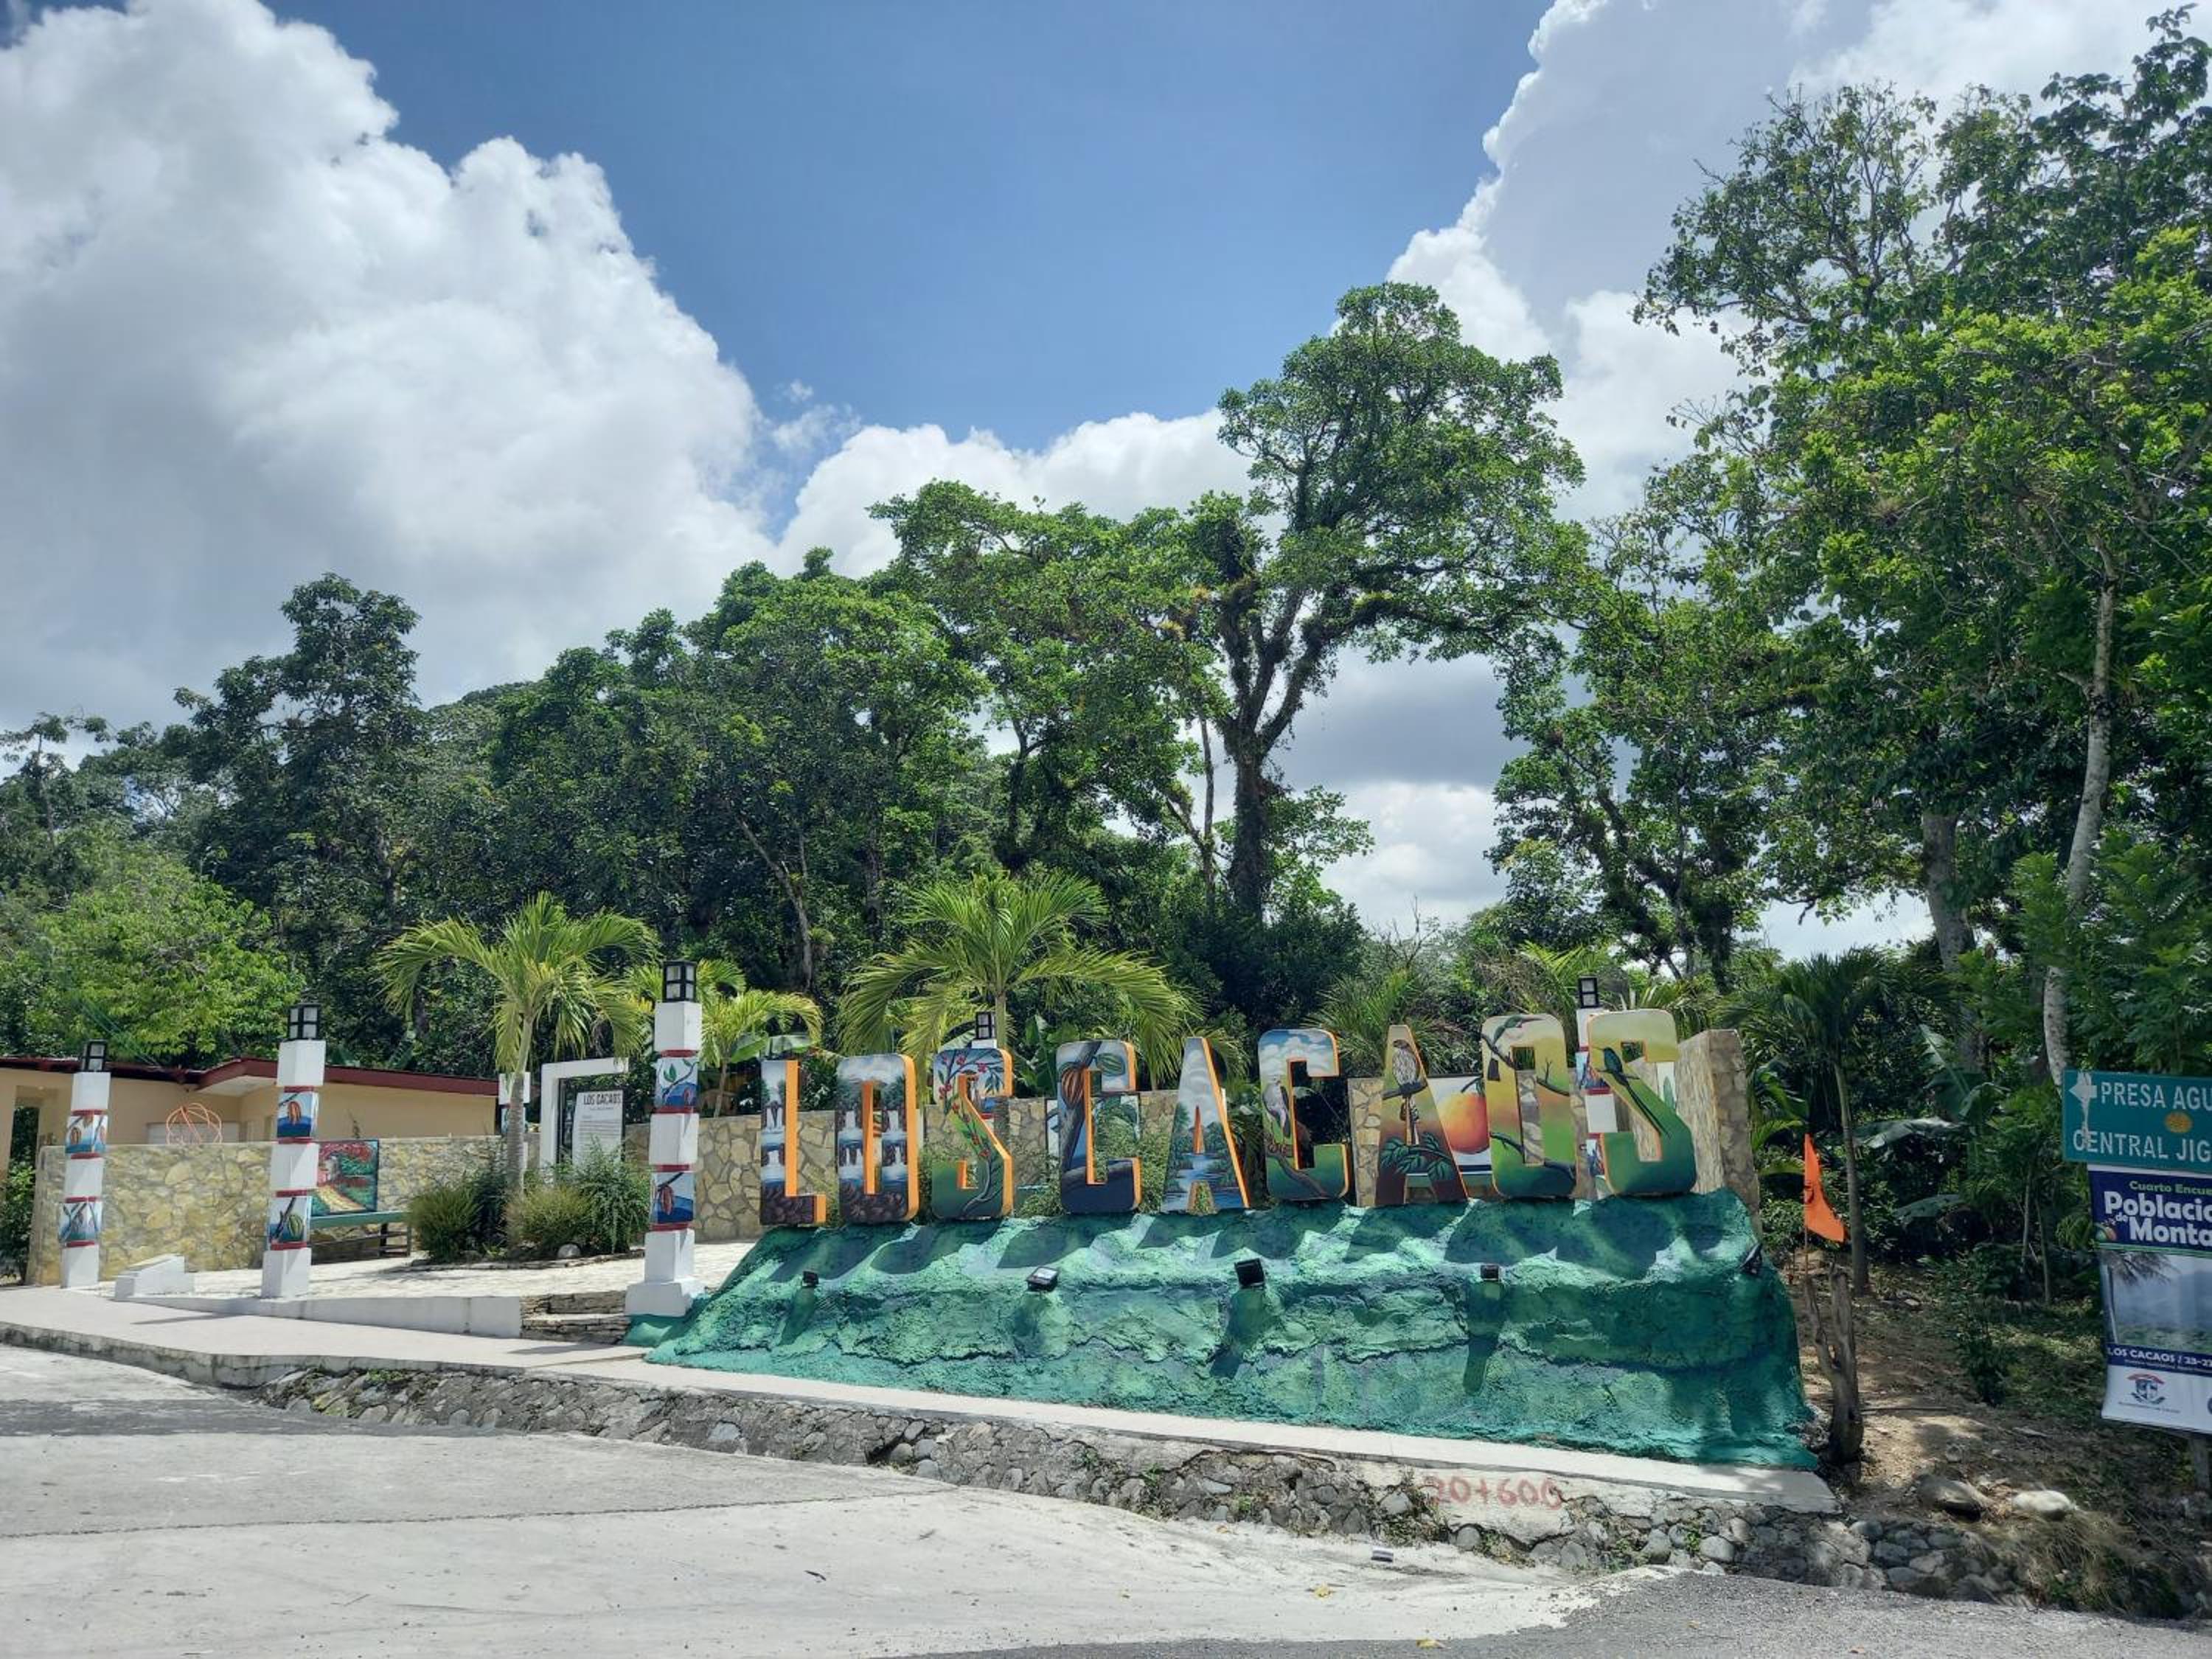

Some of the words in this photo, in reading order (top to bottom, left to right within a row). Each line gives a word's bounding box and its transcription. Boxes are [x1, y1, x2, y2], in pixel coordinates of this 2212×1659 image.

[583, 1093, 595, 1105] LOS
[2101, 1082, 2166, 1108] PRESA
[760, 1048, 1014, 1226] LOS
[1056, 1009, 1697, 1215] CACAOS
[2073, 1128, 2168, 1160] CENTRAL
[2176, 1138, 2212, 1163] JIG
[2129, 1180, 2171, 1192] Cuarto
[2115, 1211, 2128, 1222] de
[2108, 1347, 2127, 1357] LOS
[2129, 1349, 2175, 1363] CACAOS
